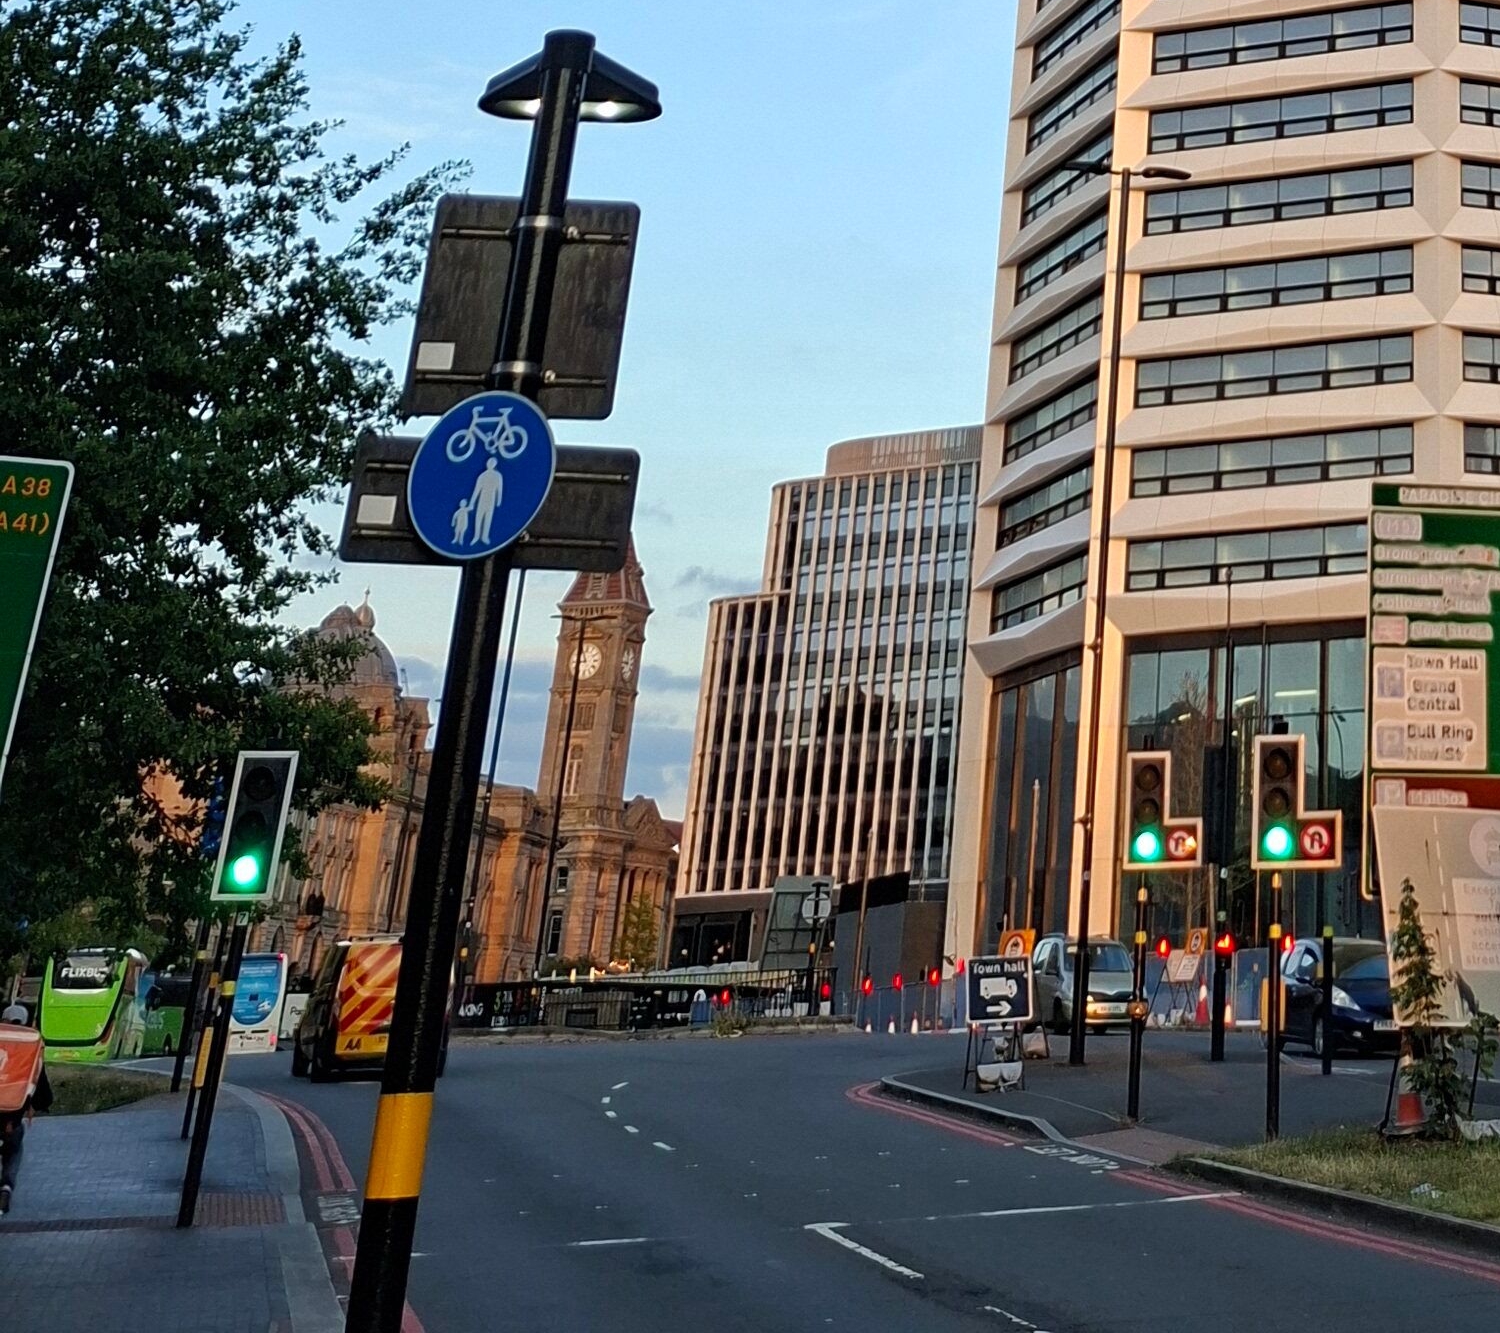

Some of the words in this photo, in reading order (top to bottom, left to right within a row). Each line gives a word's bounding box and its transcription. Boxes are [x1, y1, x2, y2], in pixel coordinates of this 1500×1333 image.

[1, 475, 52, 496] A38
[1402, 489, 1475, 504] PARADISE
[1406, 654, 1444, 670] Town
[1449, 655, 1478, 670] Hall
[1413, 679, 1456, 694] Grand
[1406, 696, 1461, 712] Central
[1406, 724, 1436, 740] Bull
[1441, 724, 1474, 742] Ring
[1463, 883, 1500, 896] Except
[1466, 954, 1500, 965] street
[972, 962, 1001, 975] Town
[1004, 960, 1026, 973] hall
